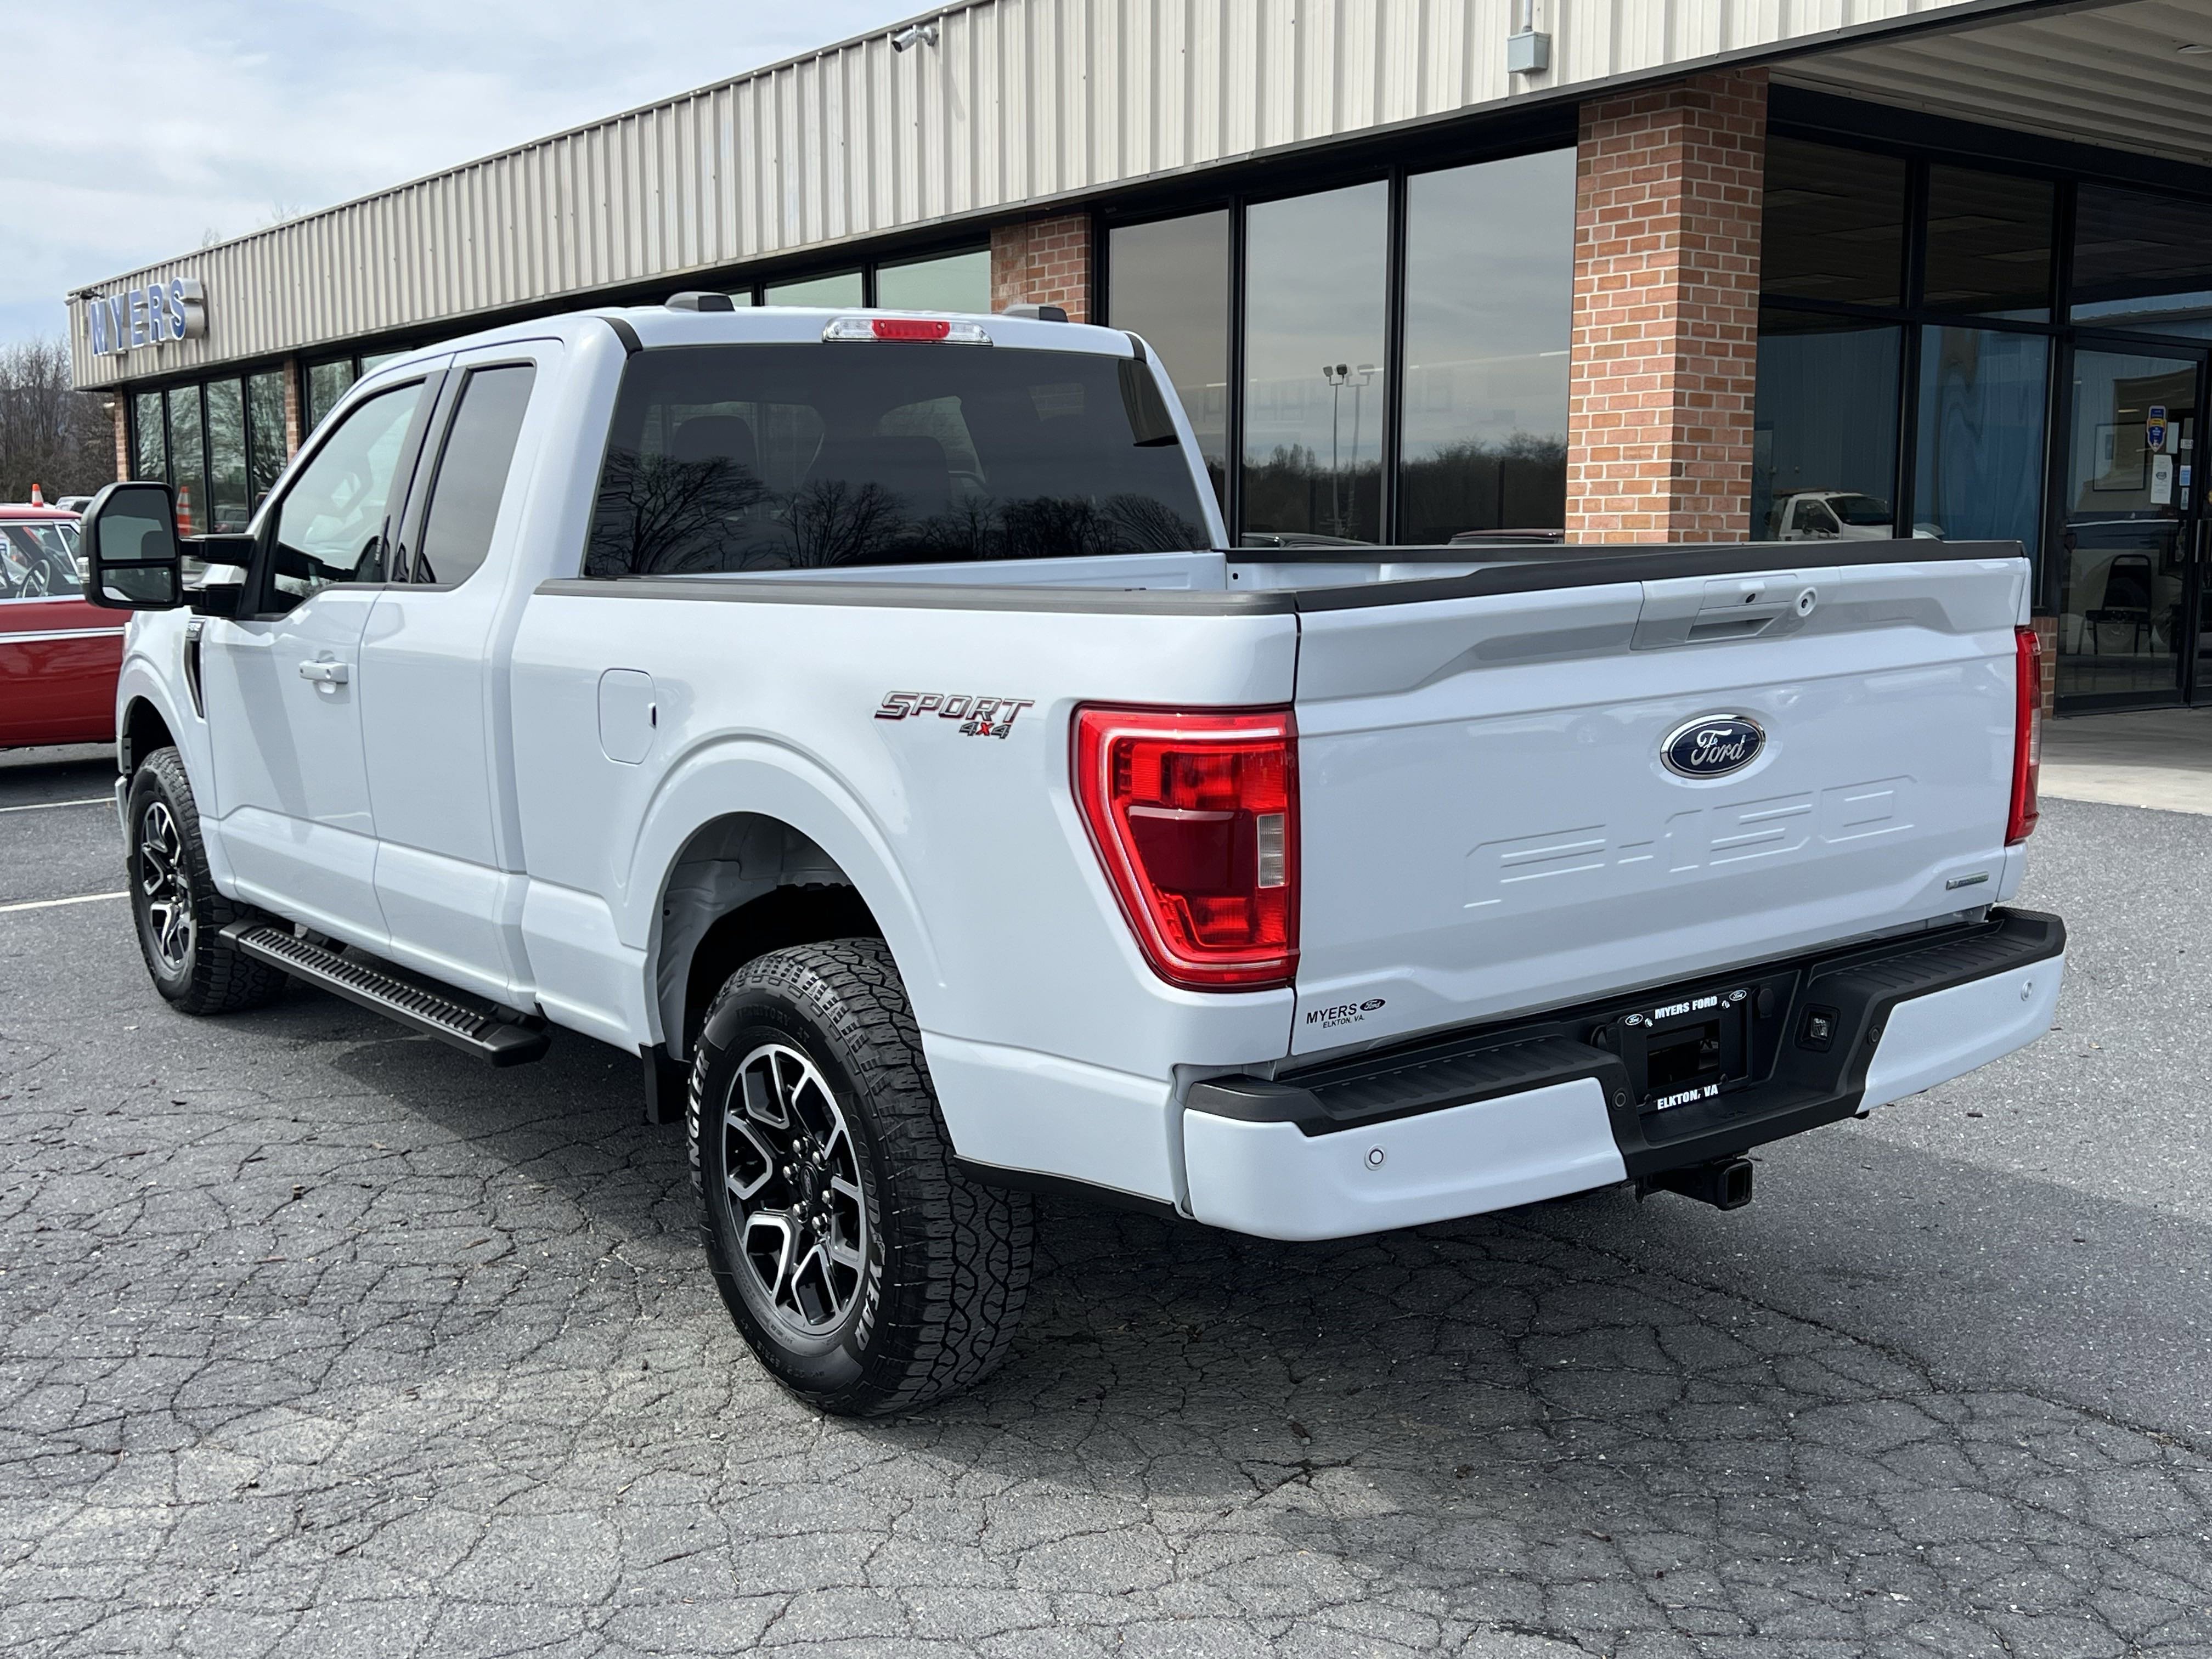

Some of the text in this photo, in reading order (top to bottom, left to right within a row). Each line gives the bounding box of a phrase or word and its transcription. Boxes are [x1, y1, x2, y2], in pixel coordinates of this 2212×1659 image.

[90, 276, 189, 356] MYERS
[874, 691, 1035, 723] SPORT
[1690, 729, 1747, 766] Ford
[1464, 774, 1917, 909] F-150
[1306, 1003, 1357, 1024] MYERS
[1655, 995, 1718, 1019] MYERS FORD
[1703, 1084, 1719, 1097] VA
